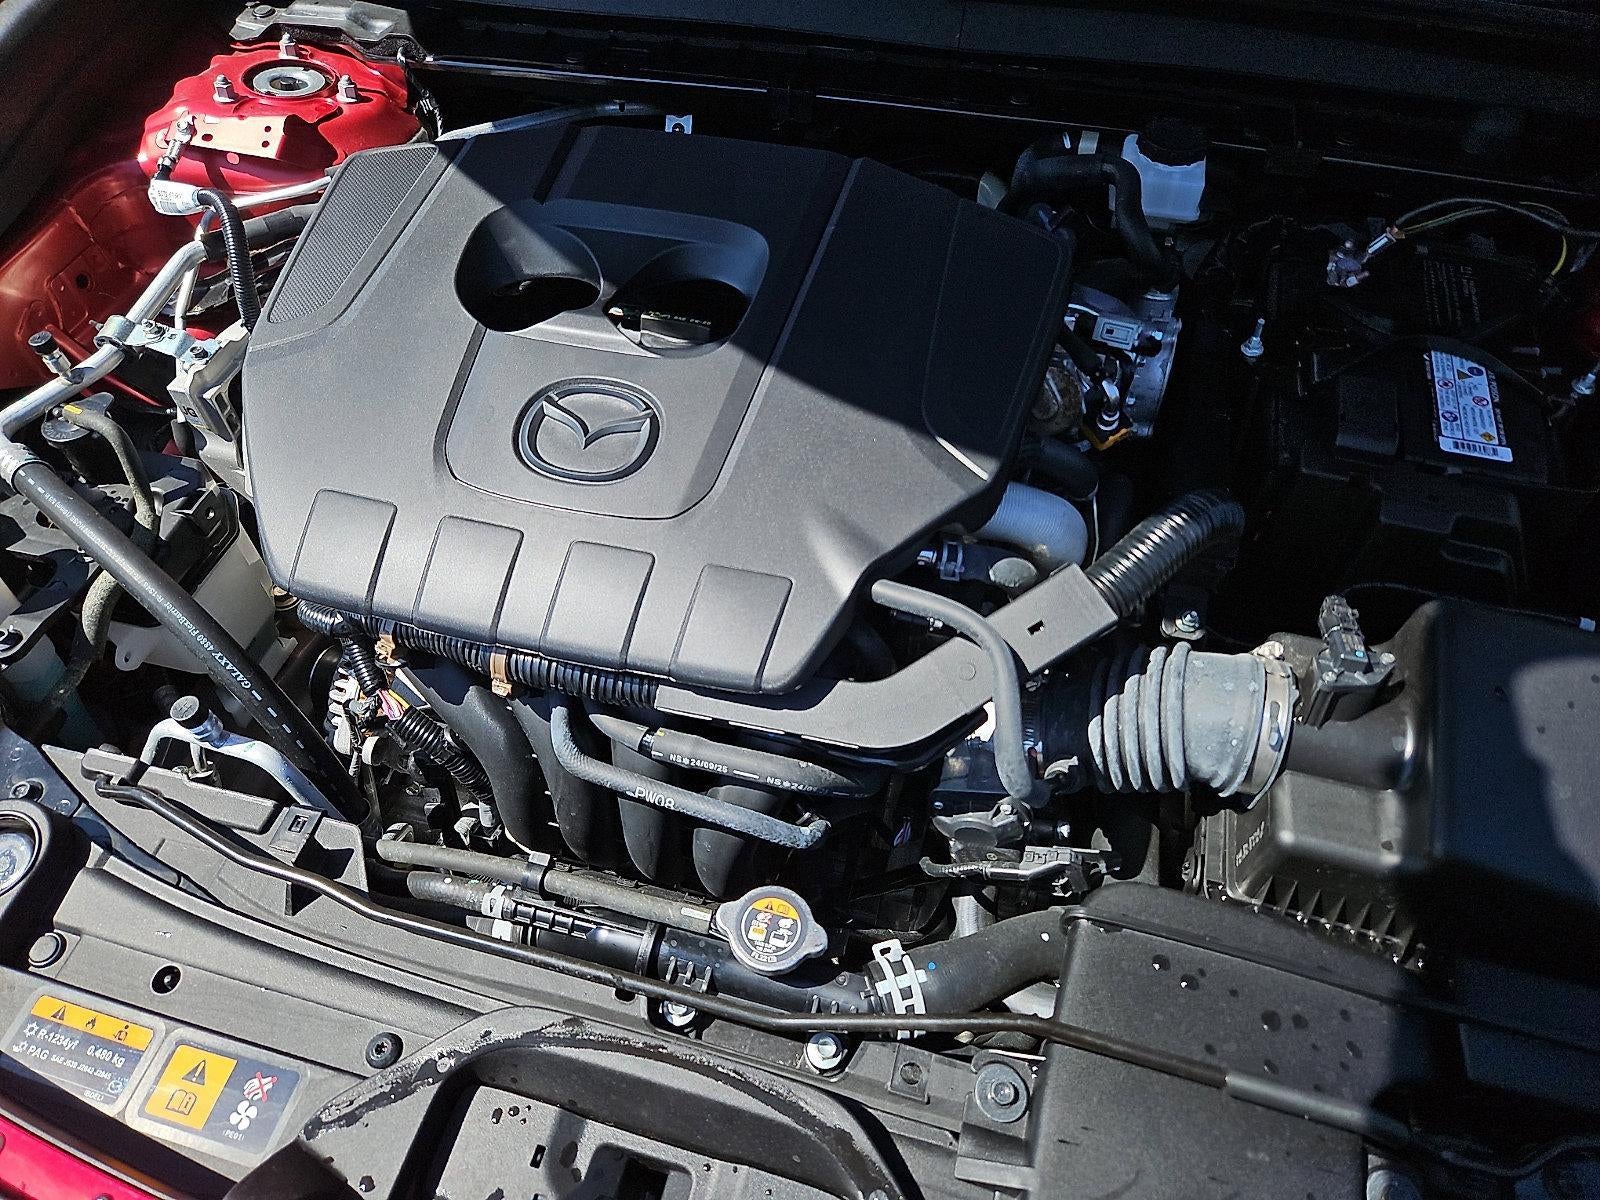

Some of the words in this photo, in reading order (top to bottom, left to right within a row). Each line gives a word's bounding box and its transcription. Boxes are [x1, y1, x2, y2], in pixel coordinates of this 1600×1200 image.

[69, 514, 85, 530] HOSE
[161, 600, 199, 637] FlexBarrier
[195, 633, 215, 653] 4880
[210, 648, 253, 690] GALAXY
[634, 785, 676, 809] PW08
[27, 1045, 50, 1061] PAG
[51, 1054, 65, 1065] SAE
[37, 1028, 80, 1050] R-1234yf
[86, 1045, 113, 1062] 0.480
[111, 1053, 126, 1068] kg
